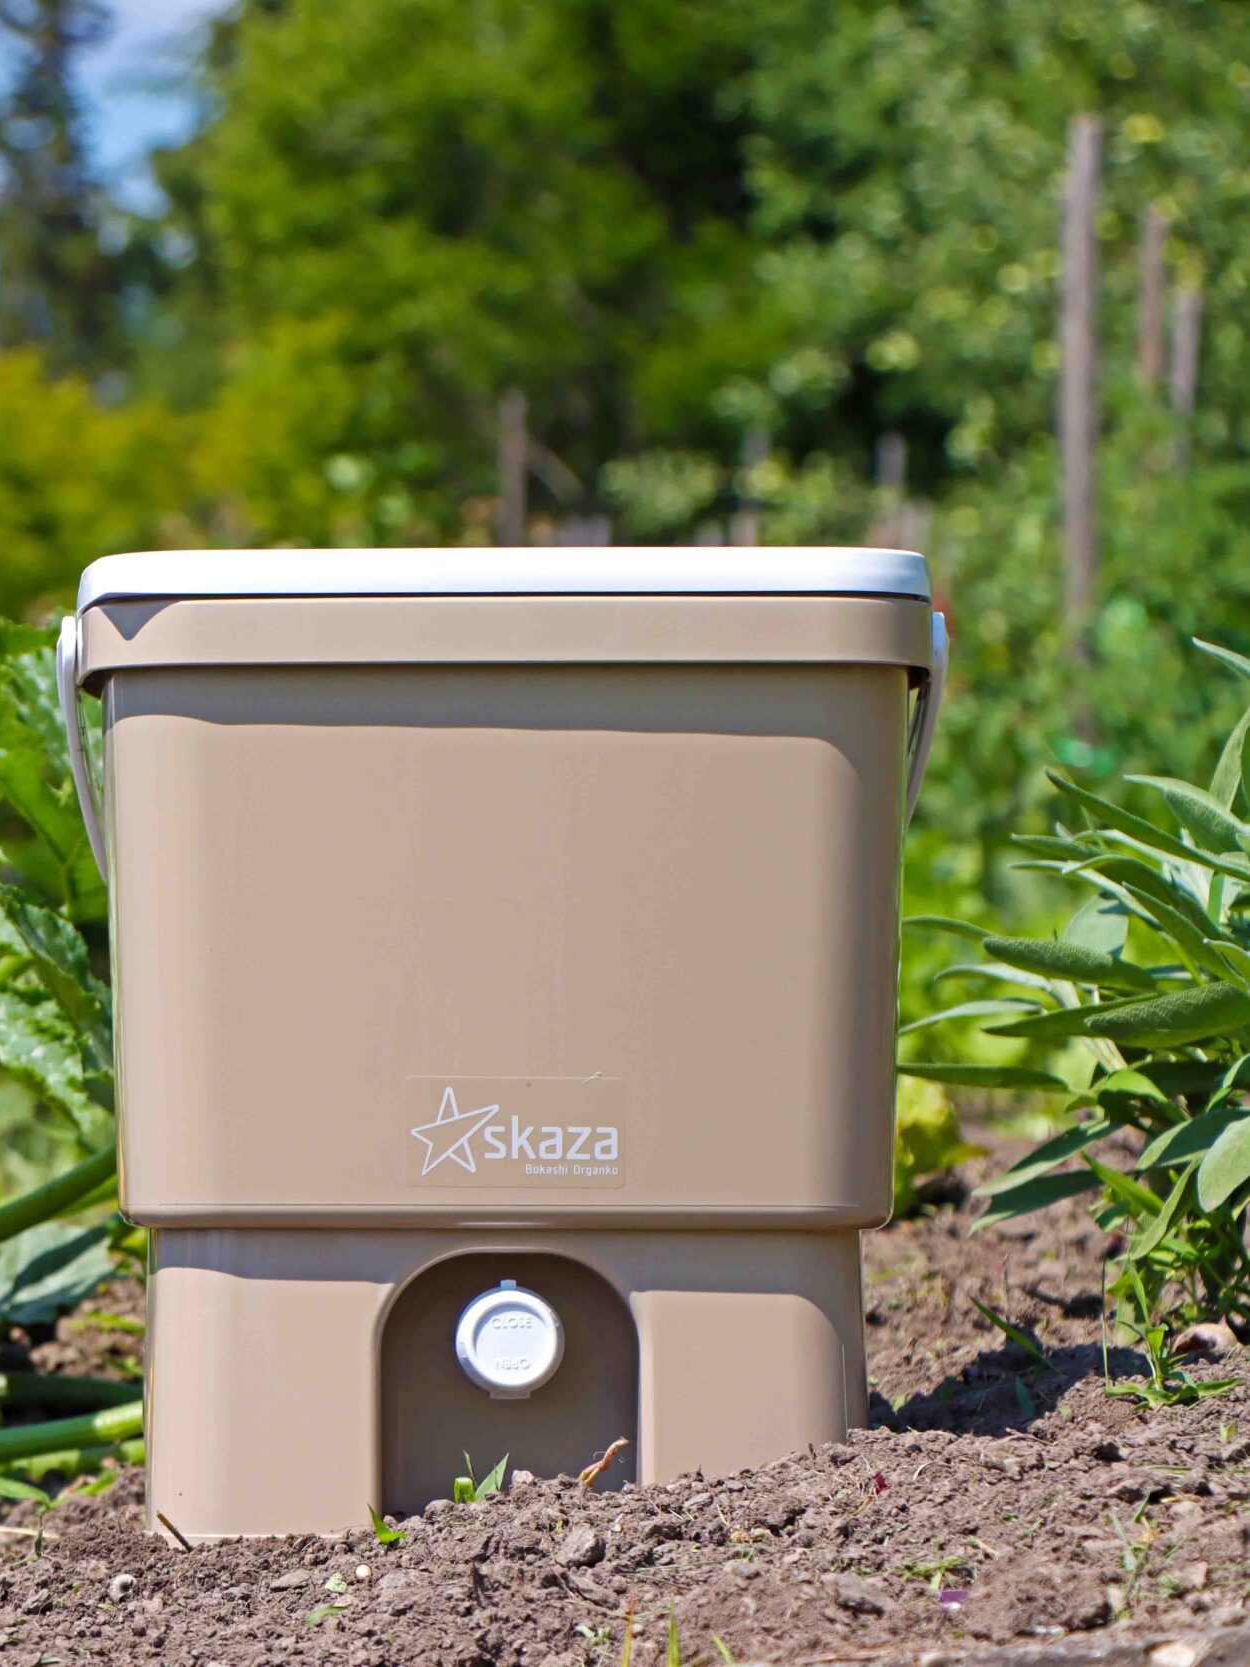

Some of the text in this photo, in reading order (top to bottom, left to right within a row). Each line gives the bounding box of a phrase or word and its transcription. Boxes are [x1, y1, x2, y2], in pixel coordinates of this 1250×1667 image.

[484, 1115, 619, 1160] skaza
[525, 1164, 619, 1177] Bokashi Organko
[492, 1316, 532, 1330] CLOSE
[495, 1358, 531, 1371] OPEN
